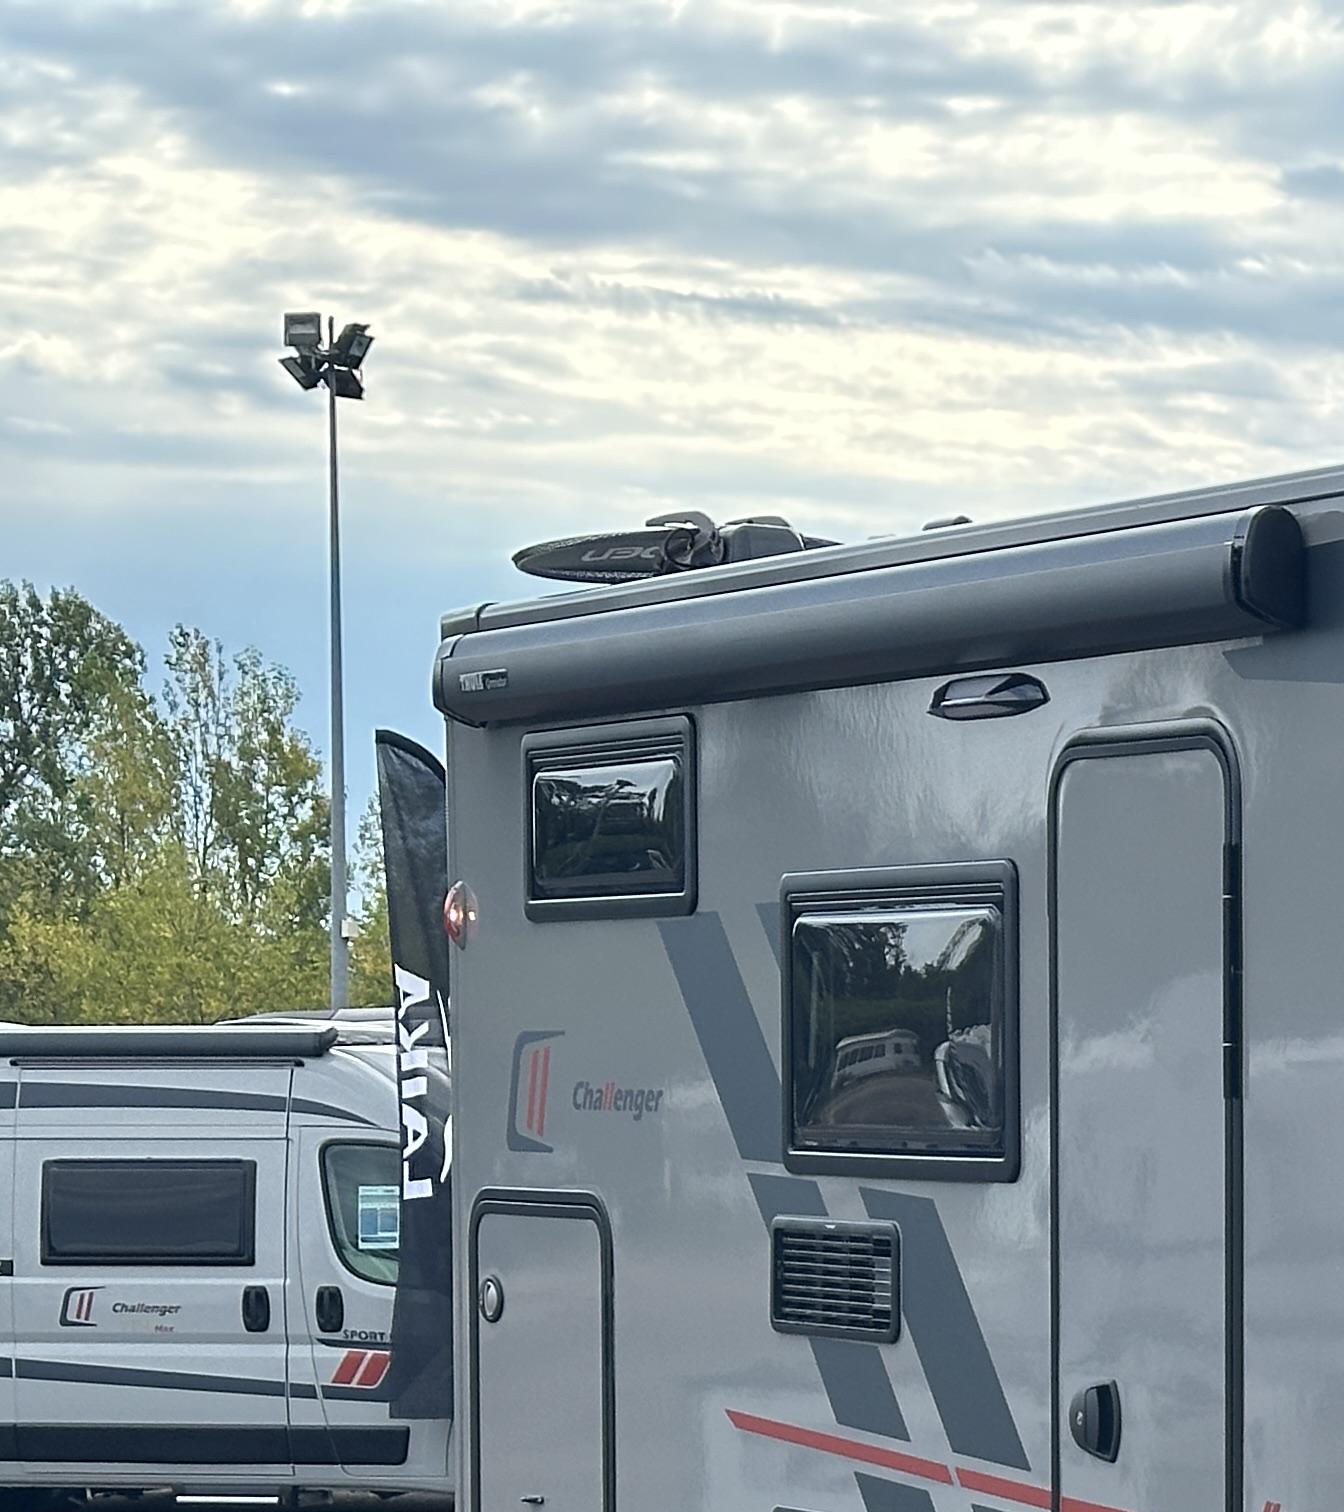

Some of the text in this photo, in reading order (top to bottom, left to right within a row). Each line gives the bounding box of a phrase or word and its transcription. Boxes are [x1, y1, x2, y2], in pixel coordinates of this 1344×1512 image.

[572, 1080, 664, 1121] Challenger
[111, 1302, 182, 1317] Challenger
[343, 1328, 386, 1341] SPORT
